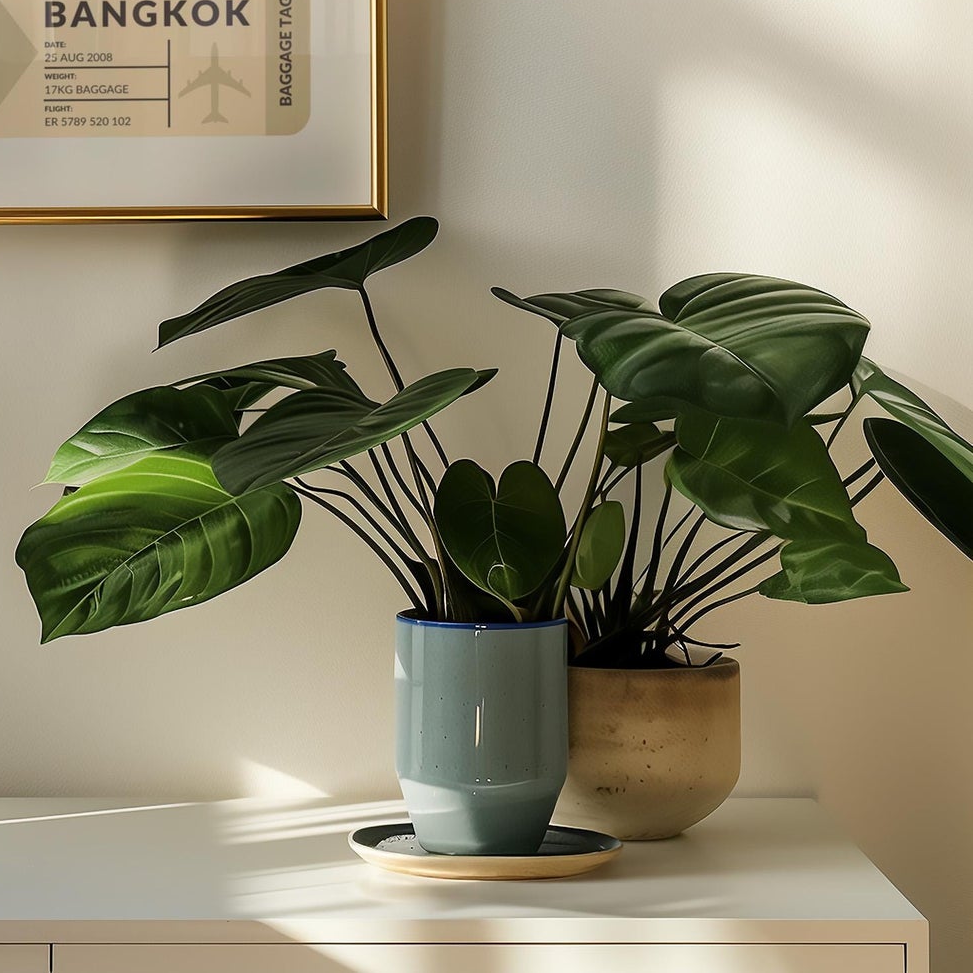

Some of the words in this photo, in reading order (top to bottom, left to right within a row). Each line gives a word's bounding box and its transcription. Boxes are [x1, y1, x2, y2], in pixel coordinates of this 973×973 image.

[45, 0, 250, 28] BANGKOK
[45, 53, 57, 62] 25
[60, 53, 84, 62] AUG
[87, 53, 113, 62] 2008
[279, 31, 292, 106] BAGGAGE
[45, 85, 73, 95] 17KG
[76, 85, 129, 94] BAGGAGE
[45, 117, 58, 126] ER
[61, 117, 86, 126] 5789
[90, 117, 109, 126] 520
[112, 117, 131, 126] 102
